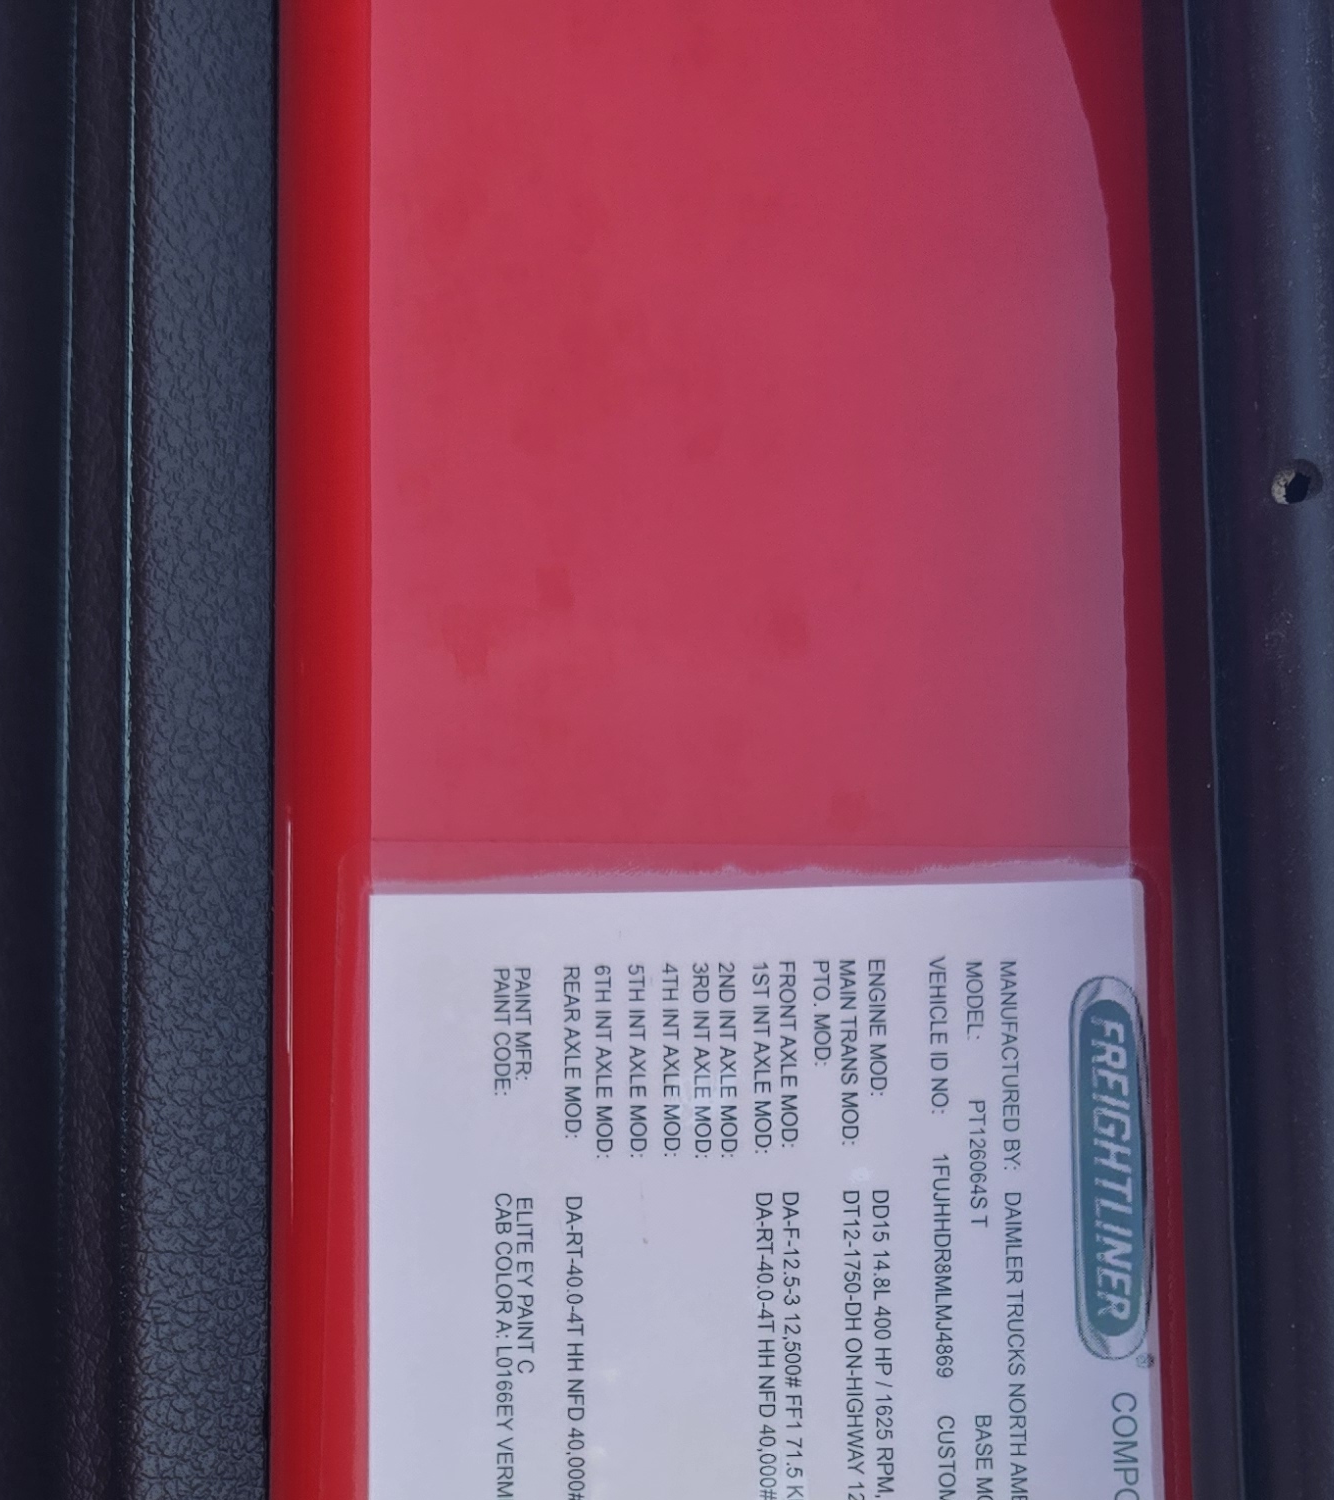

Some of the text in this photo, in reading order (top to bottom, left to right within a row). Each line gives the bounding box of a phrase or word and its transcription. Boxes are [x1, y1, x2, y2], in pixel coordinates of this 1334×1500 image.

[493, 968, 512, 1096] PAINT CODE:
[514, 967, 533, 1081] PAINT MFR:
[812, 959, 832, 1067] PTO. MOD:
[868, 958, 888, 1096] ENGINE MOD:
[965, 961, 985, 1040] MODEL:
[999, 960, 1020, 1133] MANUFACTURED
[563, 965, 583, 1139] REAR AXLE MOD:
[661, 962, 681, 1157] 4TH INT AXLE MOD:
[692, 962, 712, 1159] 3RD INT AXLE MOD:
[718, 961, 739, 1158] 2ND INT AXLE MOD:
[752, 961, 773, 1154] 1ST INT AXLE MOD:
[778, 960, 799, 1148] FRONT AXLE MOD:
[838, 959, 860, 1146] MAIN TRANS MOD:
[928, 955, 954, 1379] VEHICLE ID NO: 1FUJHHDR8MLMJ4869
[968, 1099, 989, 1228] PT126064S T
[1003, 1138, 1021, 1171] BY:
[1090, 1015, 1134, 1324] FREIGHTLINER
[494, 1192, 513, 1235] CAB
[782, 1191, 801, 1306] DA-F-12.5-3
[842, 1189, 863, 1331] DT12-1750-DH
[872, 1189, 890, 1243] DD15
[1004, 1192, 1024, 1285] DAIMLER
[494, 1241, 514, 1315] COLOR
[516, 1197, 535, 1374] ELITE EY PAINT C
[565, 1196, 585, 1337] DA-RT-40.0-4T
[872, 1250, 892, 1301] 14.8L
[495, 1319, 513, 1339] A:
[566, 1342, 585, 1372] HH
[755, 1192, 778, 1500] DA-RT-40.0-4T HH NFD 40,000#
[781, 1313, 802, 1389] 12,500#
[873, 1305, 892, 1340] 400
[874, 1347, 893, 1376] HP
[1006, 1289, 1026, 1376] TRUCKS
[495, 1345, 514, 1432] L0166EY
[567, 1378, 585, 1422] NFD
[785, 1394, 804, 1429] FF1
[844, 1337, 865, 1475] ON-HIGHWAY
[875, 1380, 894, 1388] /
[875, 1394, 894, 1441] 1625
[1008, 1383, 1028, 1456] NORTH
[785, 1437, 804, 1479] 71.5
[874, 1447, 895, 1498] RPM,
[974, 1414, 994, 1471] BASE
